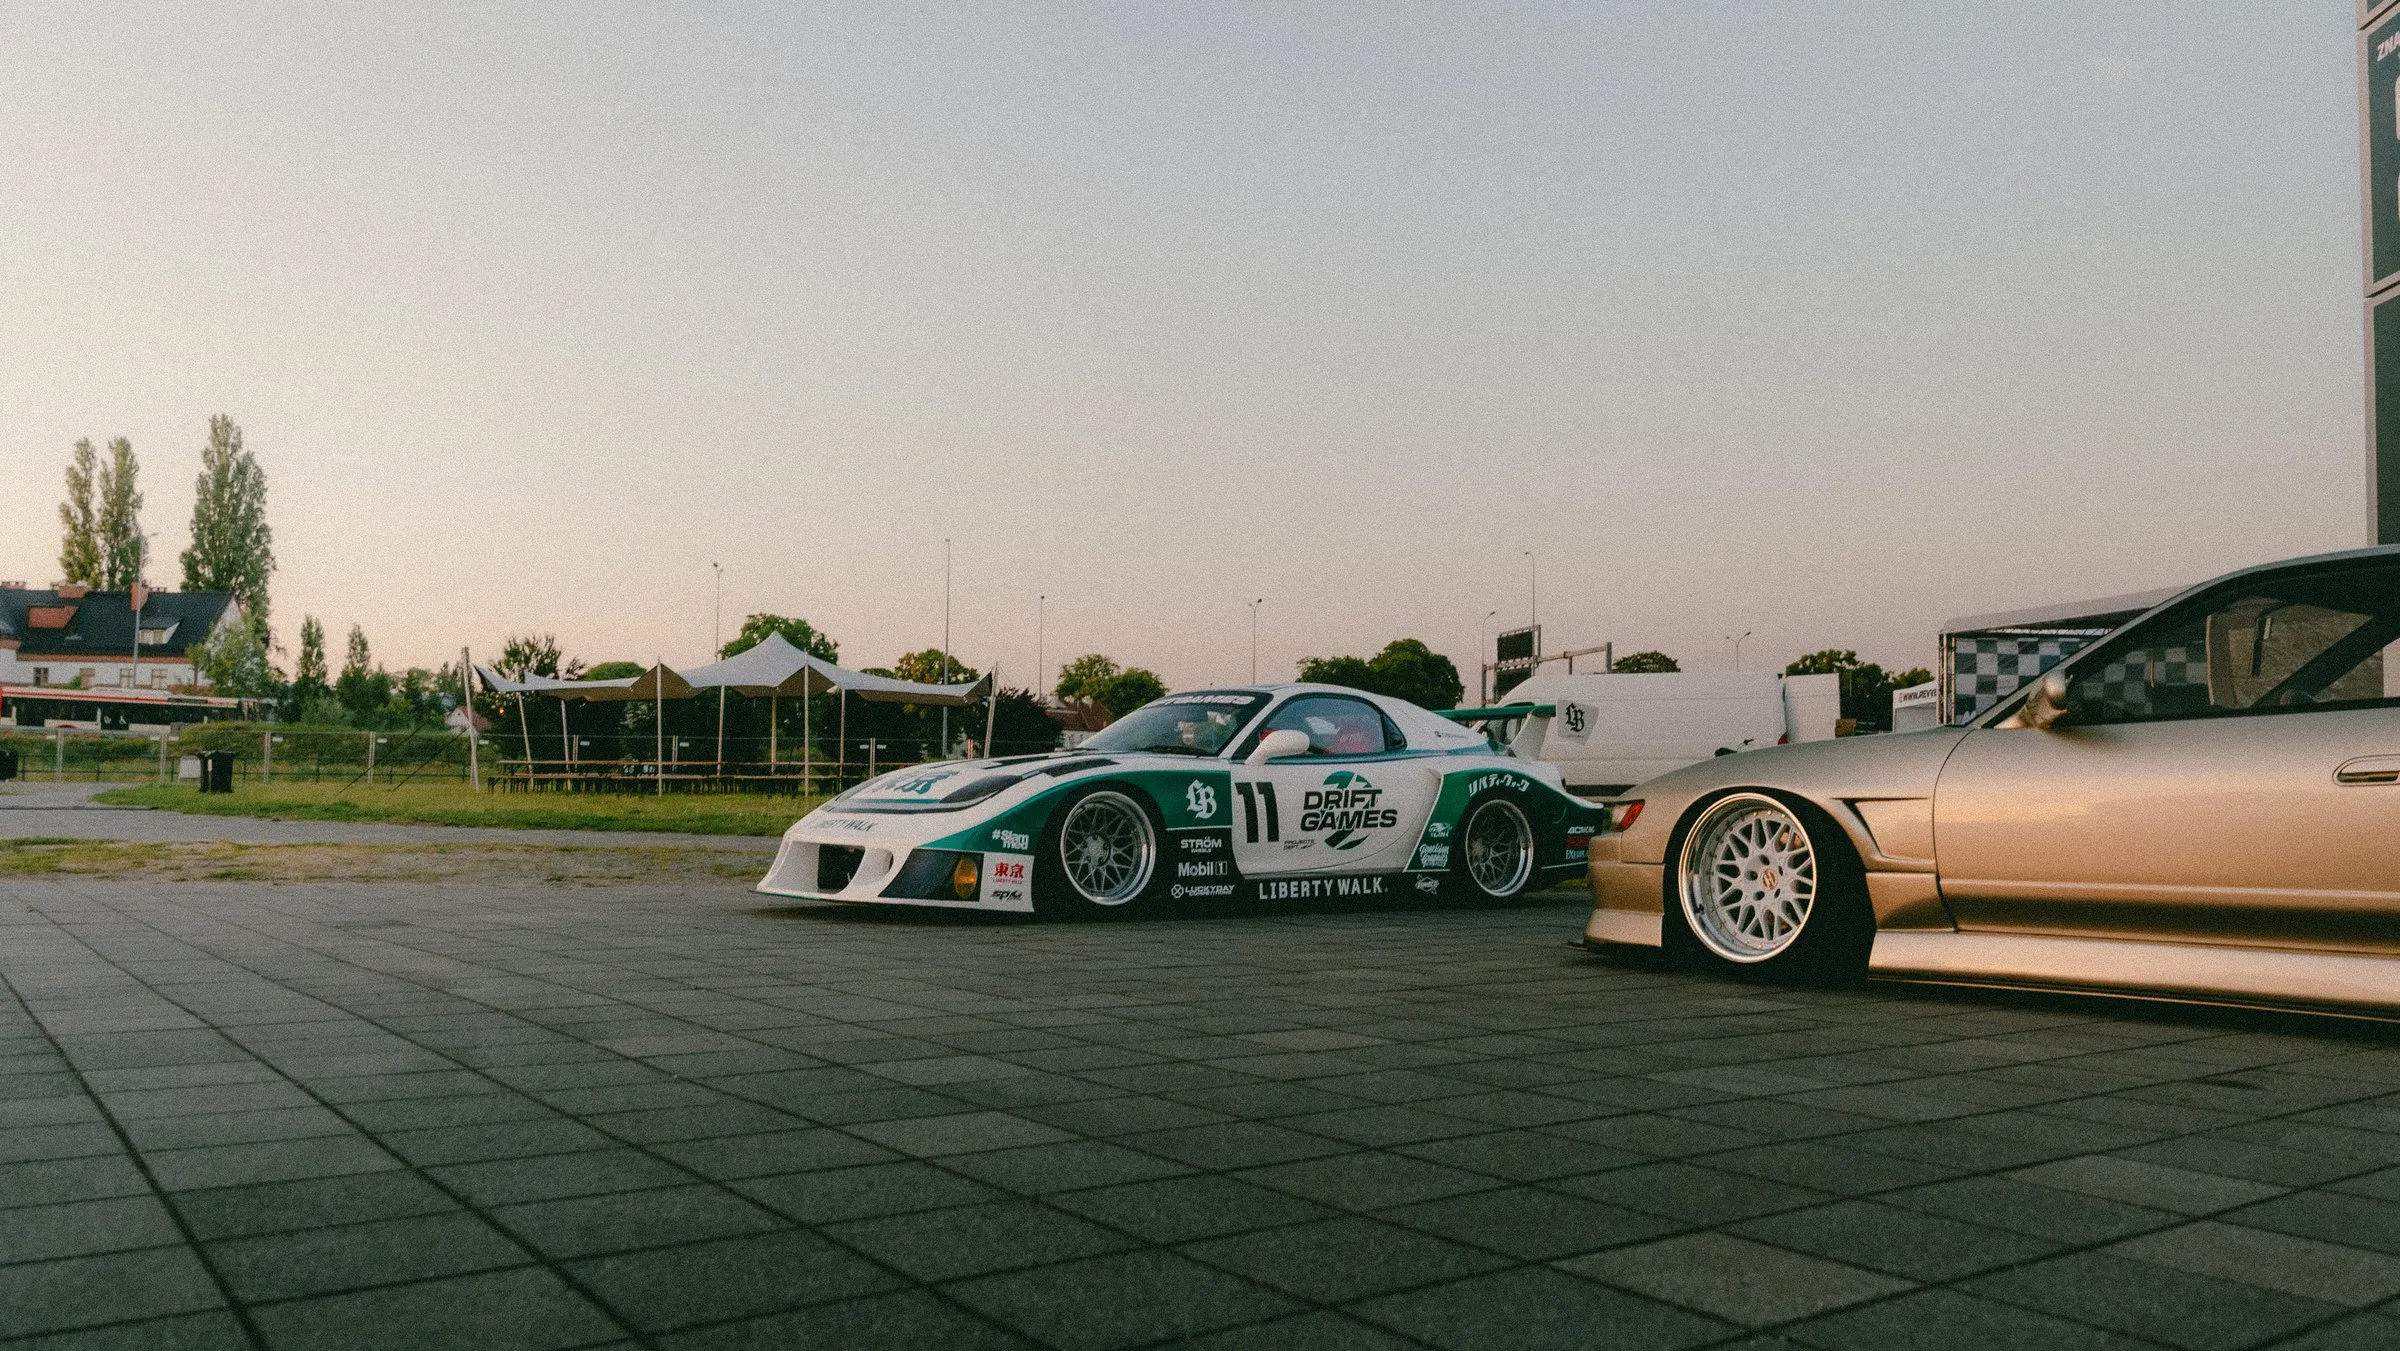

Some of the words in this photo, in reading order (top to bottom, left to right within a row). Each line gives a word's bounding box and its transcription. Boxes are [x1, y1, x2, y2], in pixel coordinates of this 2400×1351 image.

[1566, 703, 1585, 732] LB
[1185, 779, 1217, 819] LB
[1303, 789, 1382, 810] DRIFT
[1235, 782, 1279, 843] 11
[1300, 809, 1398, 832] GAMES
[1180, 836, 1222, 849] STRÖM
[994, 862, 1024, 879] 東京
[1178, 861, 1214, 877] Mobil
[1185, 884, 1235, 893] LUCKYDAY
[1259, 880, 1333, 899] LIBERTY
